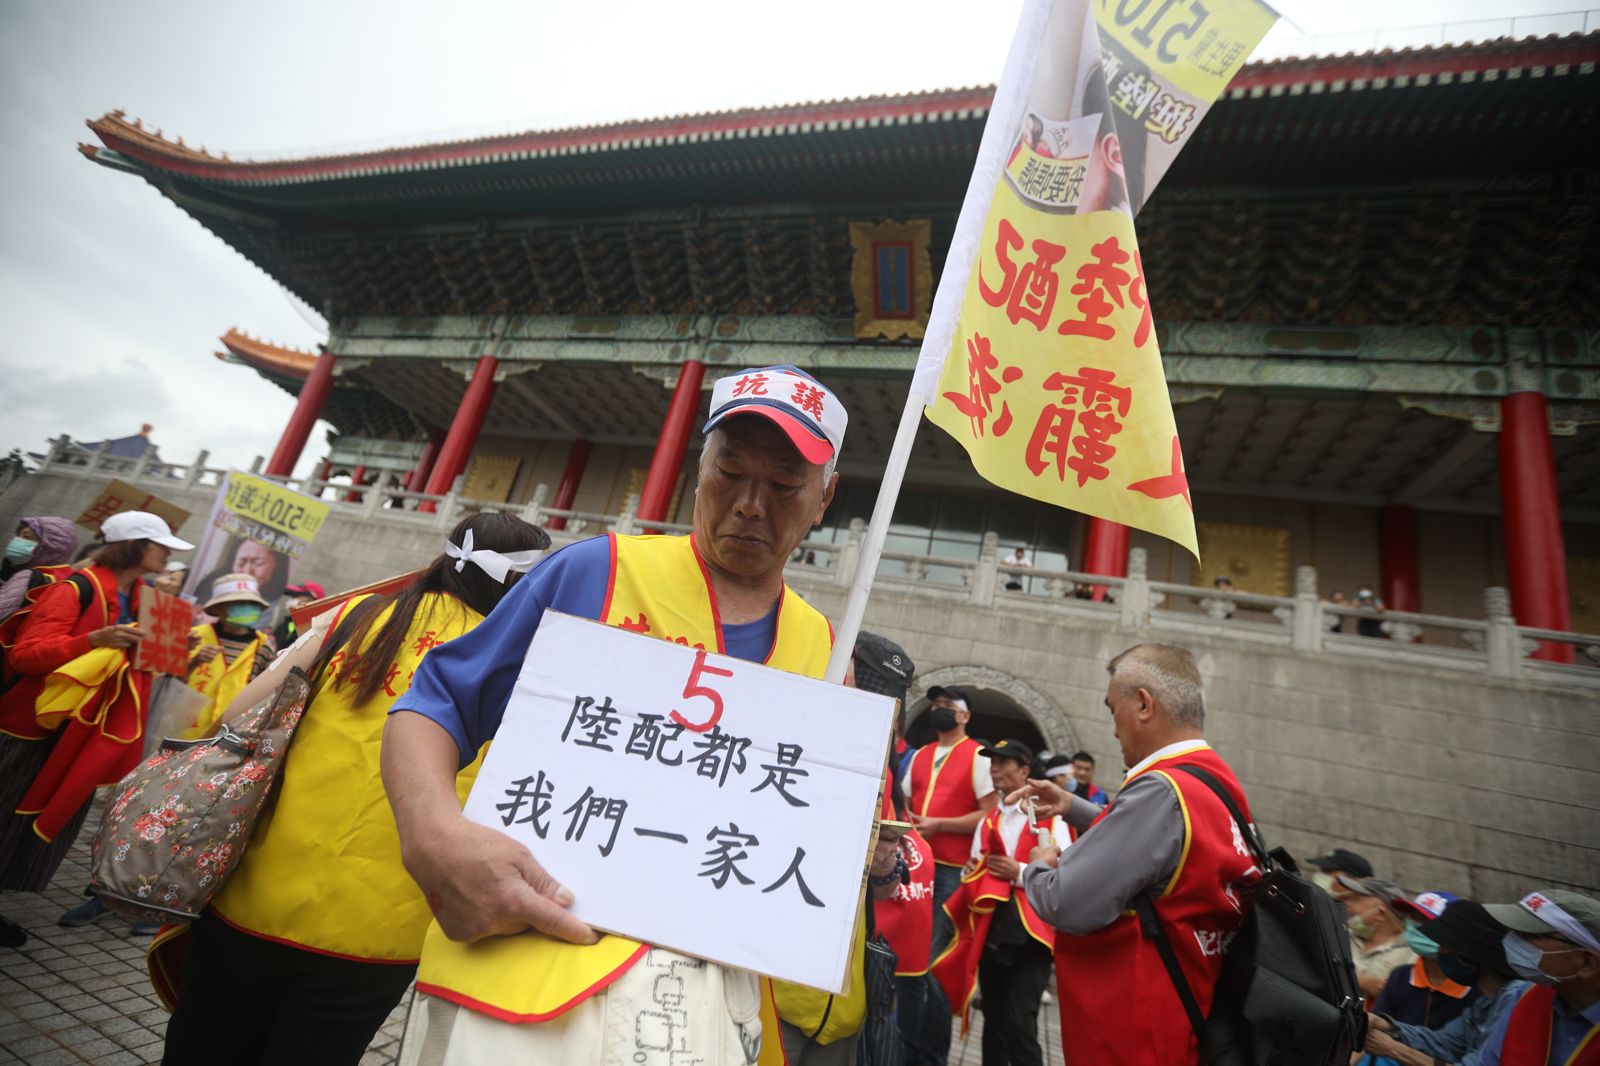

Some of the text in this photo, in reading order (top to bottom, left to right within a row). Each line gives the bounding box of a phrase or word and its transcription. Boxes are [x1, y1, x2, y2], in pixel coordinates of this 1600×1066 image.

[732, 373, 826, 423] 抗議
[668, 650, 734, 733] 5
[561, 695, 811, 808] 陸配都是
[496, 770, 826, 908] 我們一家人
